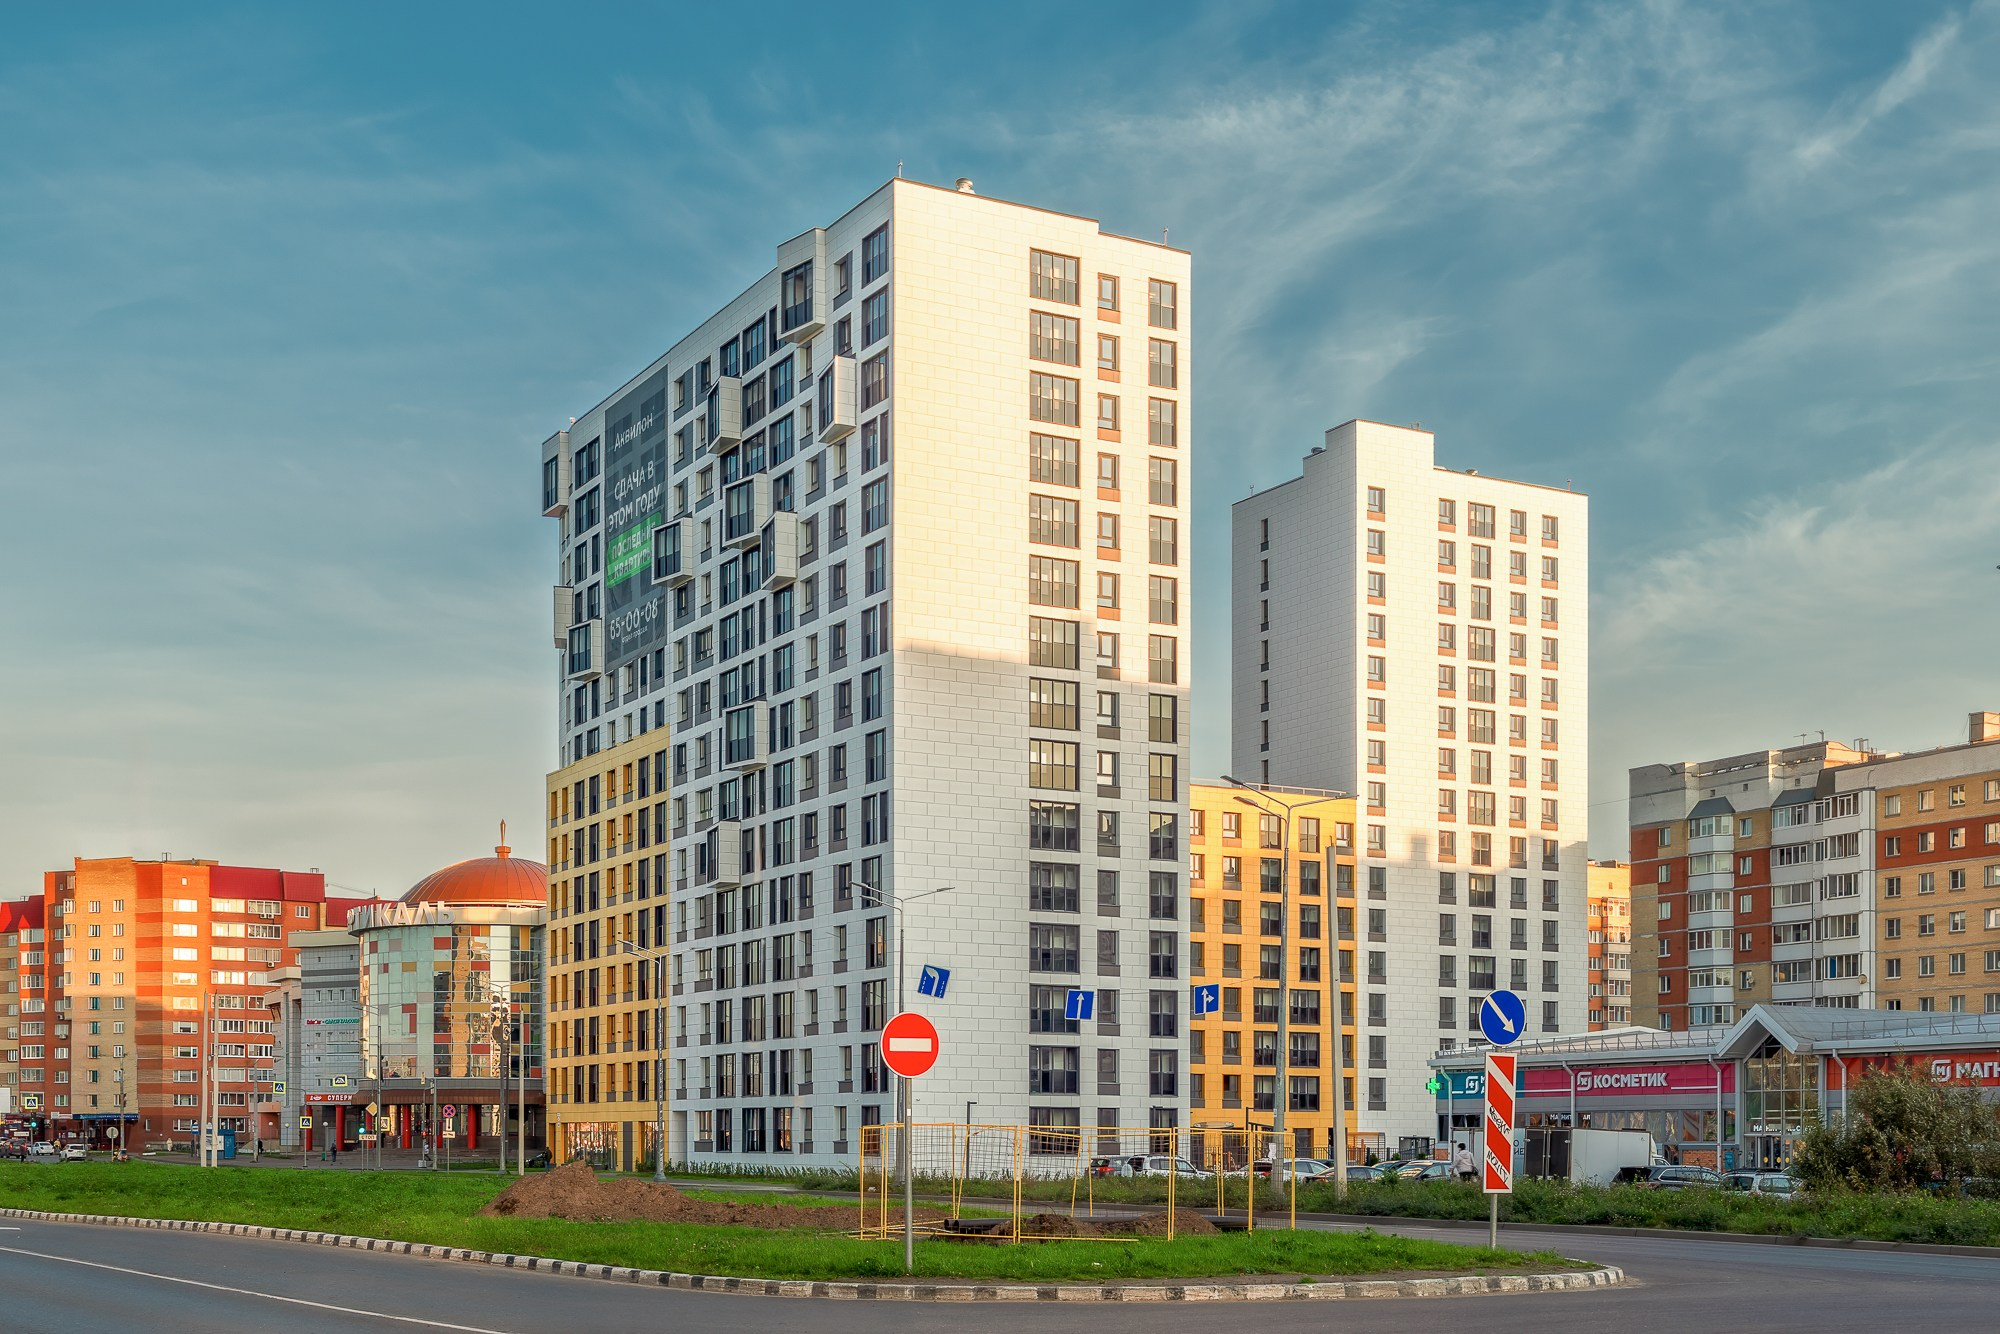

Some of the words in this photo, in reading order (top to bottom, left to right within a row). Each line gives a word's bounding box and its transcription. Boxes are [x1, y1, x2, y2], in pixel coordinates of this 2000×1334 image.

[614, 412, 653, 452] Аквилон
[614, 465, 646, 501] СДАЧА
[647, 460, 654, 480] В
[608, 501, 633, 533] ЭТОМ
[635, 483, 661, 517] ГОДУ
[612, 521, 656, 560] ПОСЛЕДНИ
[610, 597, 658, 640] 65-00-08
[1593, 1072, 1668, 1089] КОСМЕТИК
